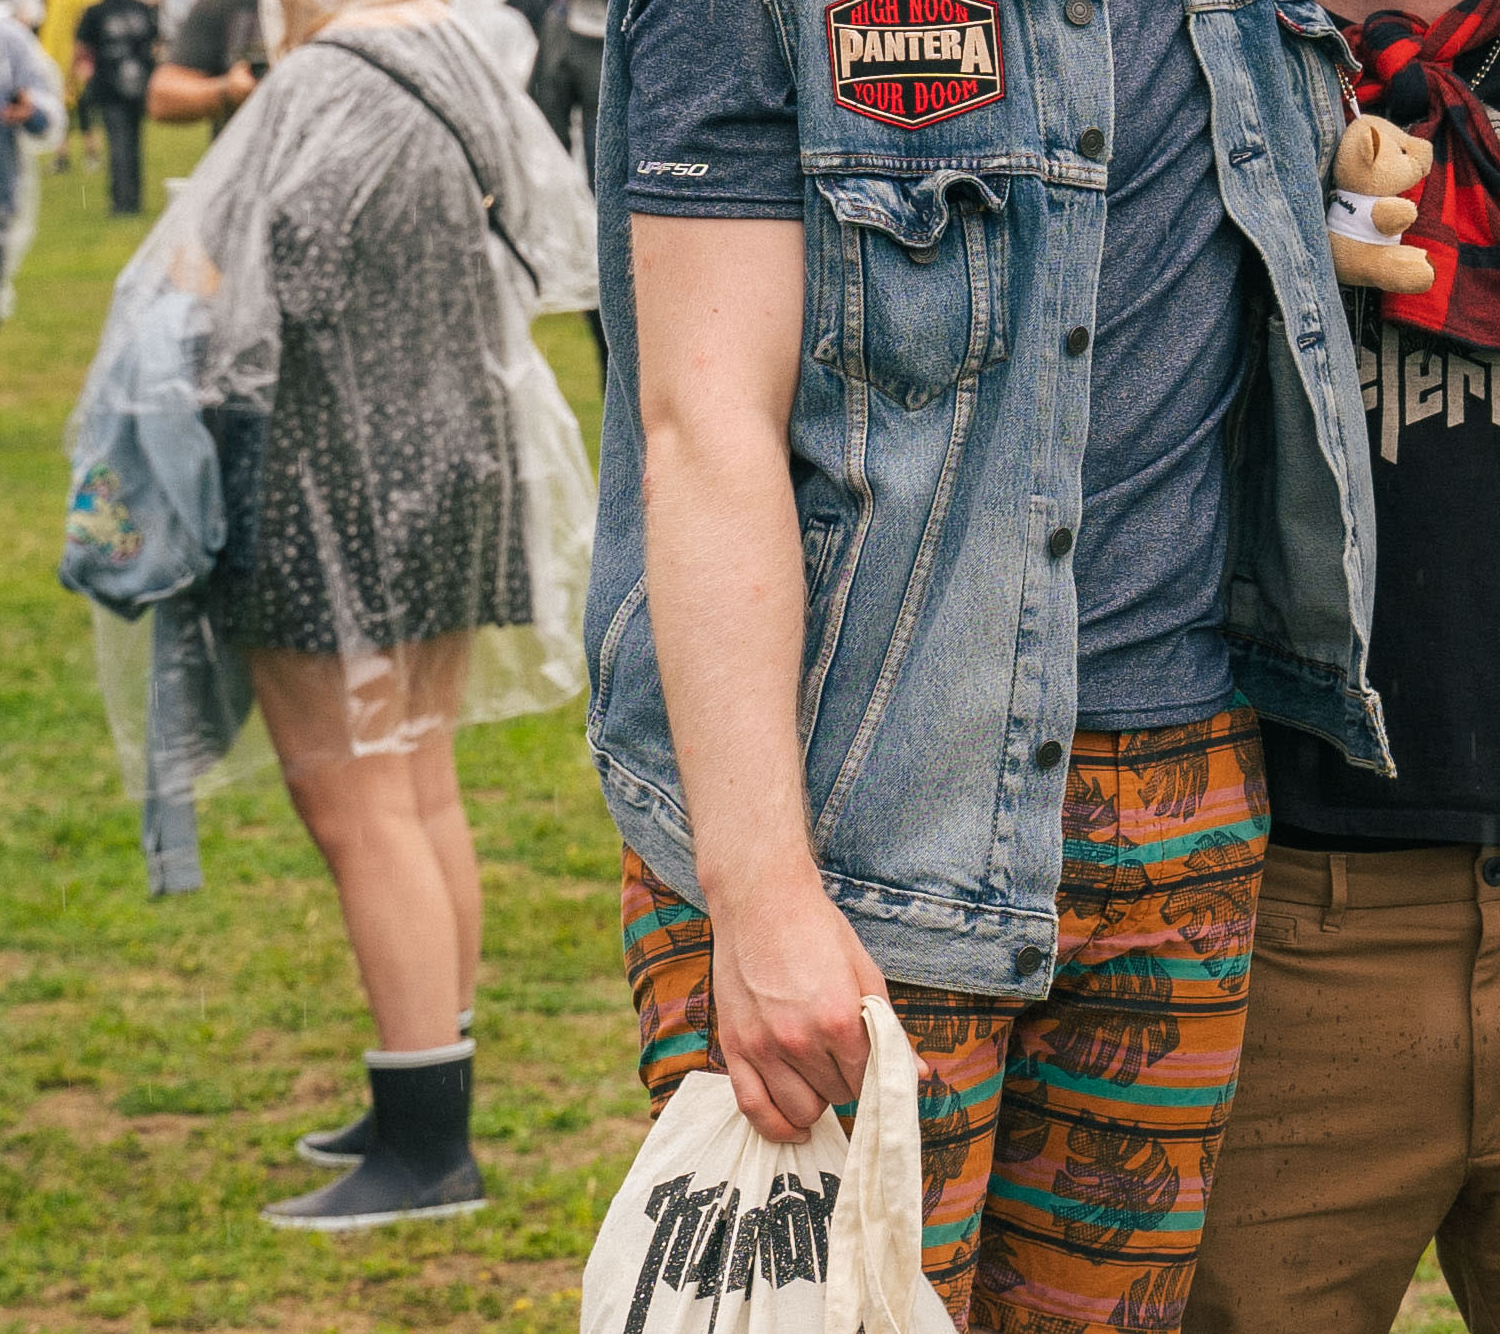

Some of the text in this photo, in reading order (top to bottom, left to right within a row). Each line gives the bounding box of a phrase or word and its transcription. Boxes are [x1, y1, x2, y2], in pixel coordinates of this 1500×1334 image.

[838, 25, 994, 79] PANTERA
[852, 79, 979, 115] YOUR DOOM
